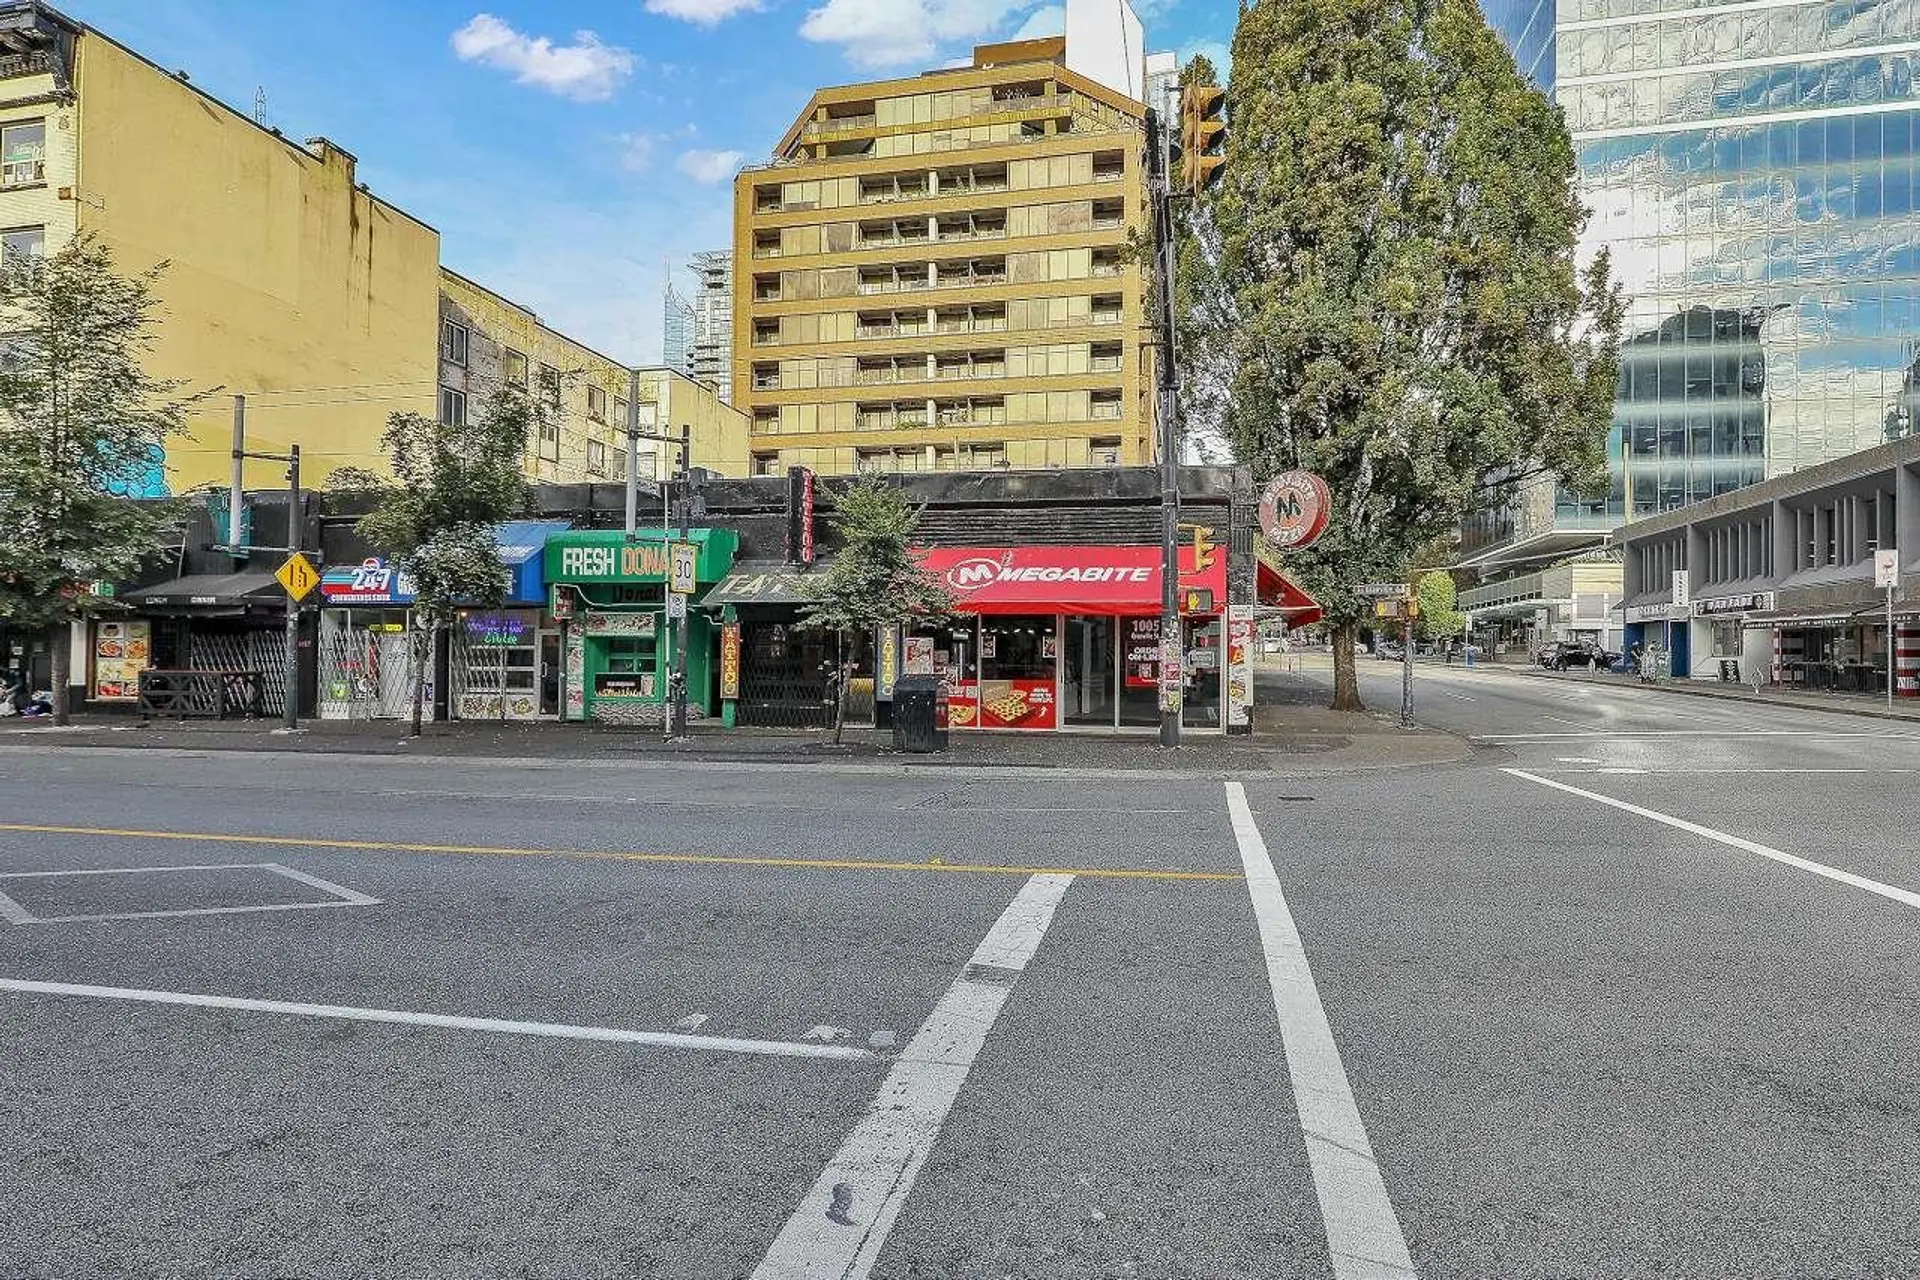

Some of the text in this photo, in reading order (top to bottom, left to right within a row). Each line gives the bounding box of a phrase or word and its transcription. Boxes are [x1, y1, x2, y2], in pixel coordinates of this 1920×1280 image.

[562, 547, 615, 576] FRESH
[675, 560, 692, 579] 30
[997, 566, 1153, 582] MEGABITE
[1132, 619, 1159, 631] 1005
